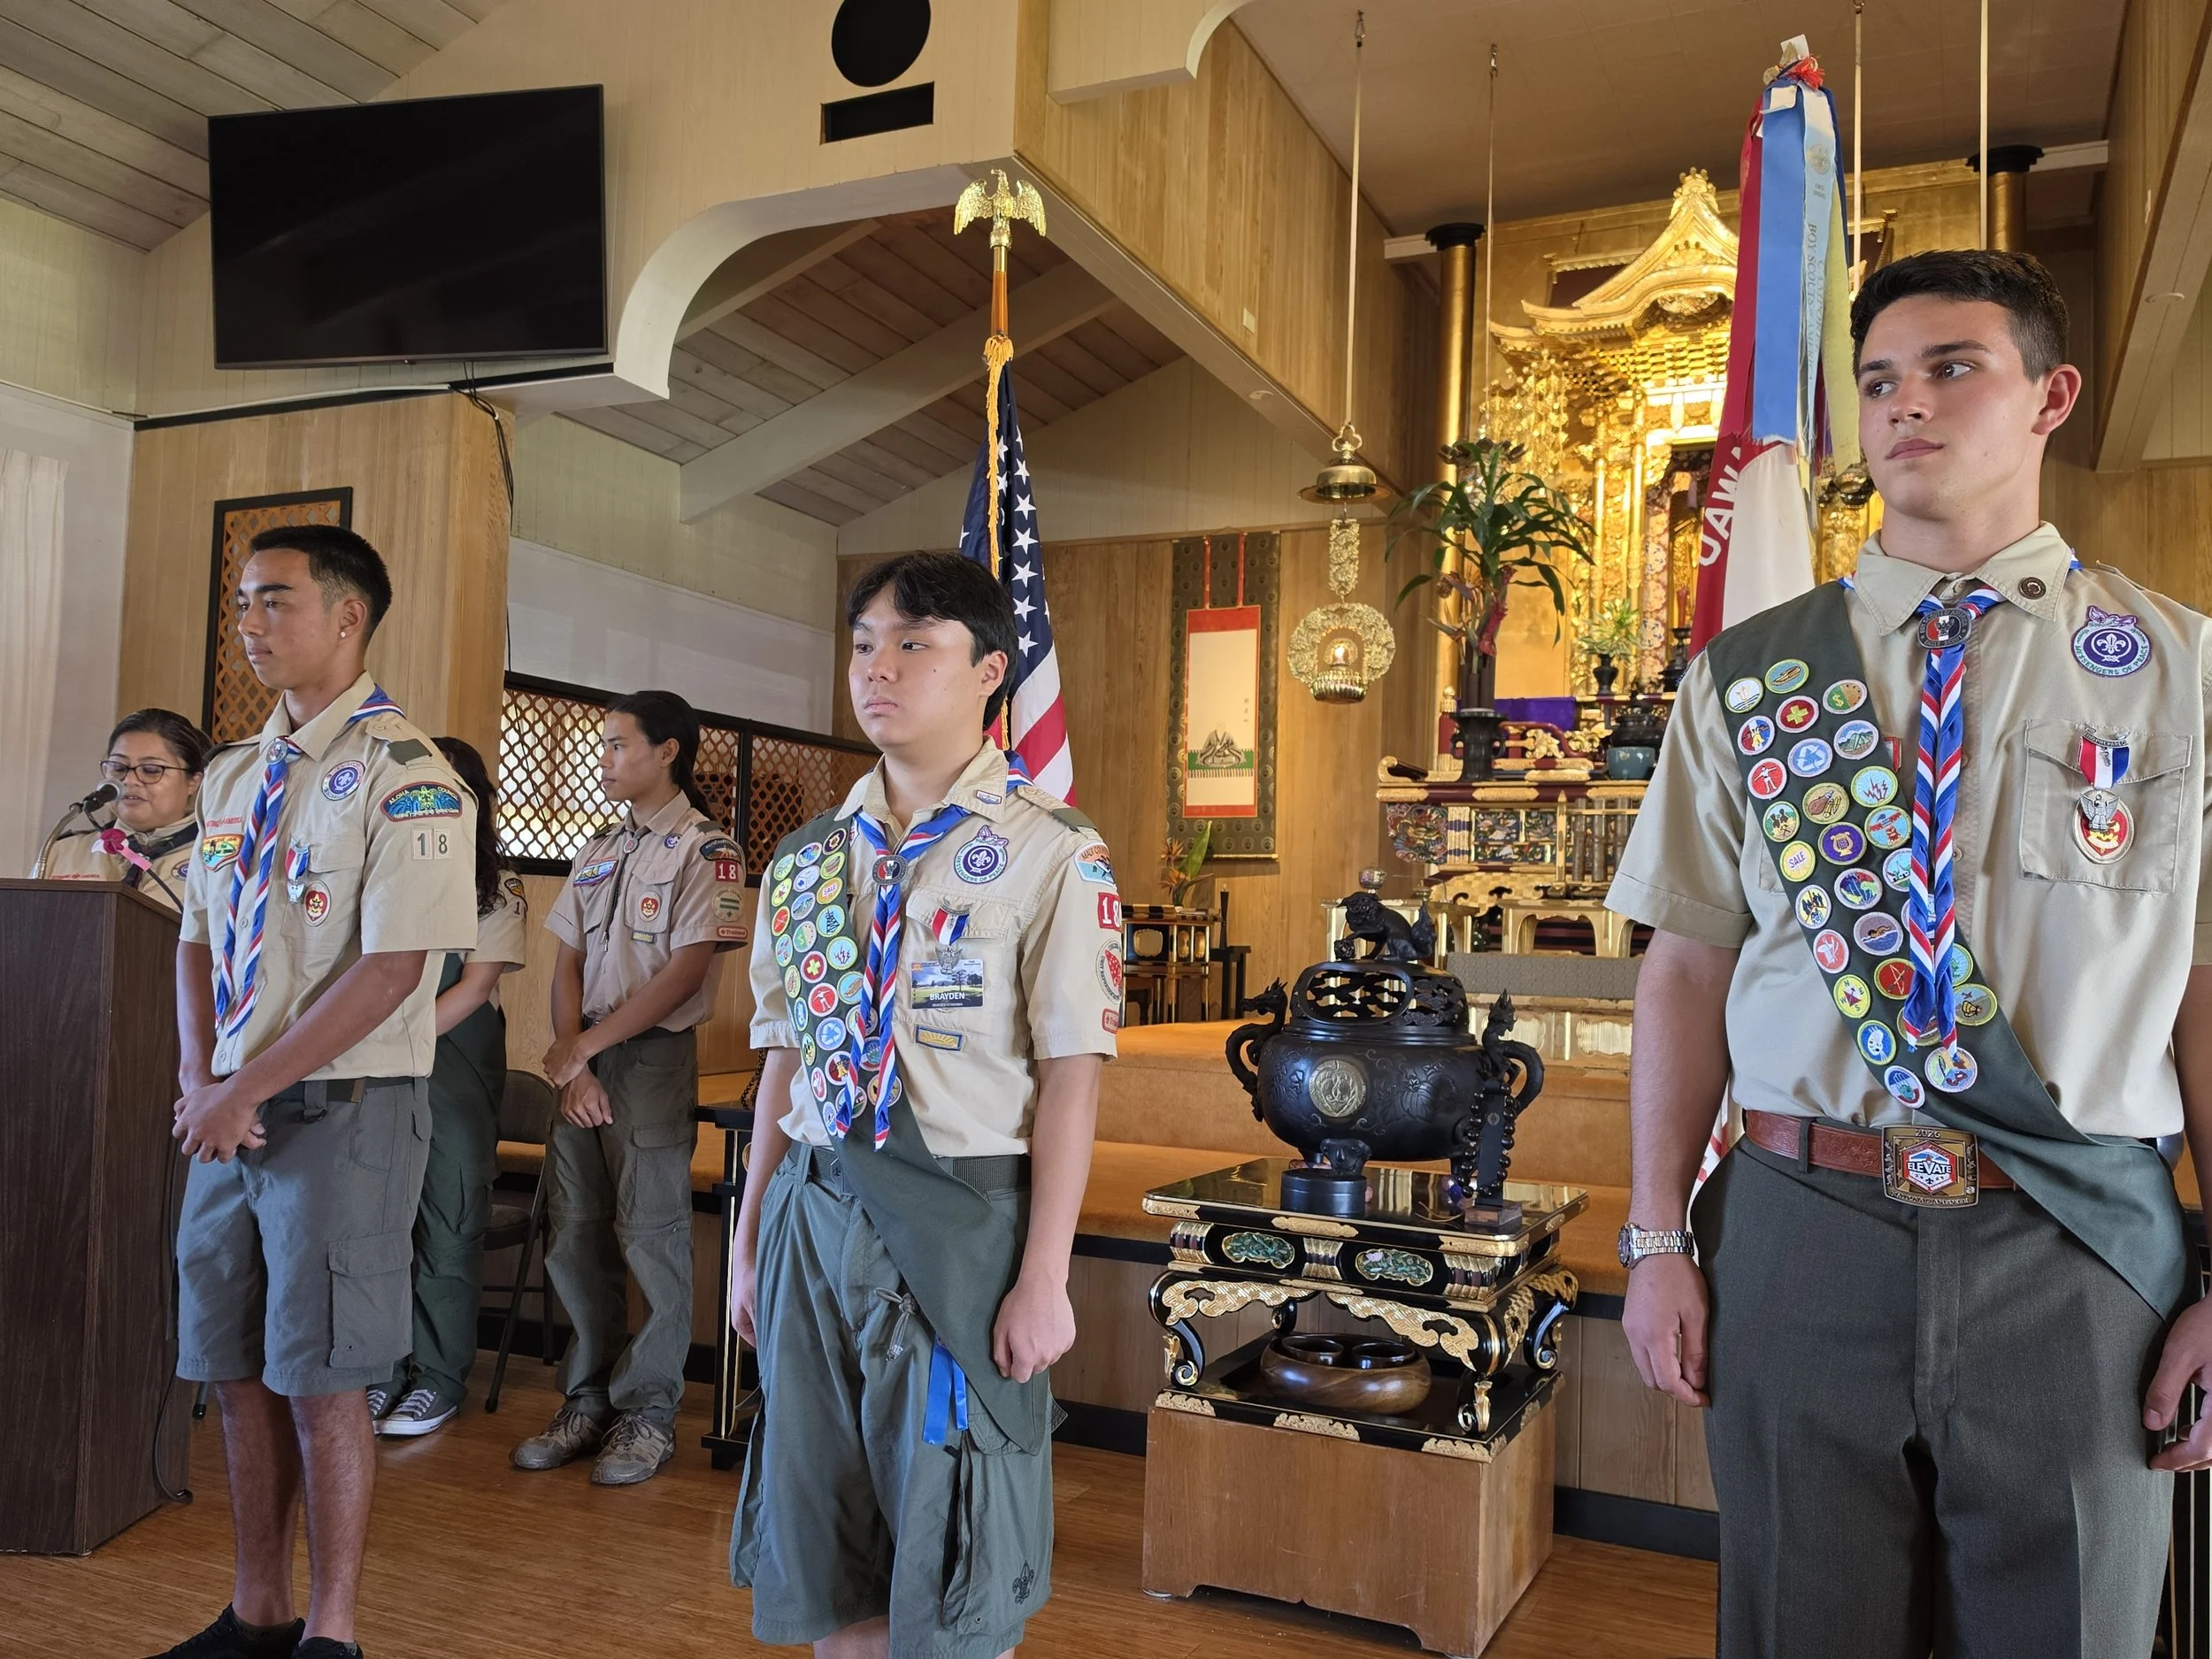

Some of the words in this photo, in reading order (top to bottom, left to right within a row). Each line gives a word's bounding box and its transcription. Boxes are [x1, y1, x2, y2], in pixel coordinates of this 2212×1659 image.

[1808, 223, 1816, 250] BOY
[1807, 255, 1816, 307] SCOUTS
[2075, 645, 2119, 675] MESSENGERS
[2134, 645, 2147, 666] PEACE
[389, 789, 410, 804] ALOHA
[1789, 851, 1806, 868] SALE
[718, 863, 736, 879] 18
[988, 864, 1004, 879] PEACE
[824, 884, 836, 895] SALE
[929, 992, 965, 1001] BRAYDEN
[1908, 1161, 1952, 1175] ELEVATE
